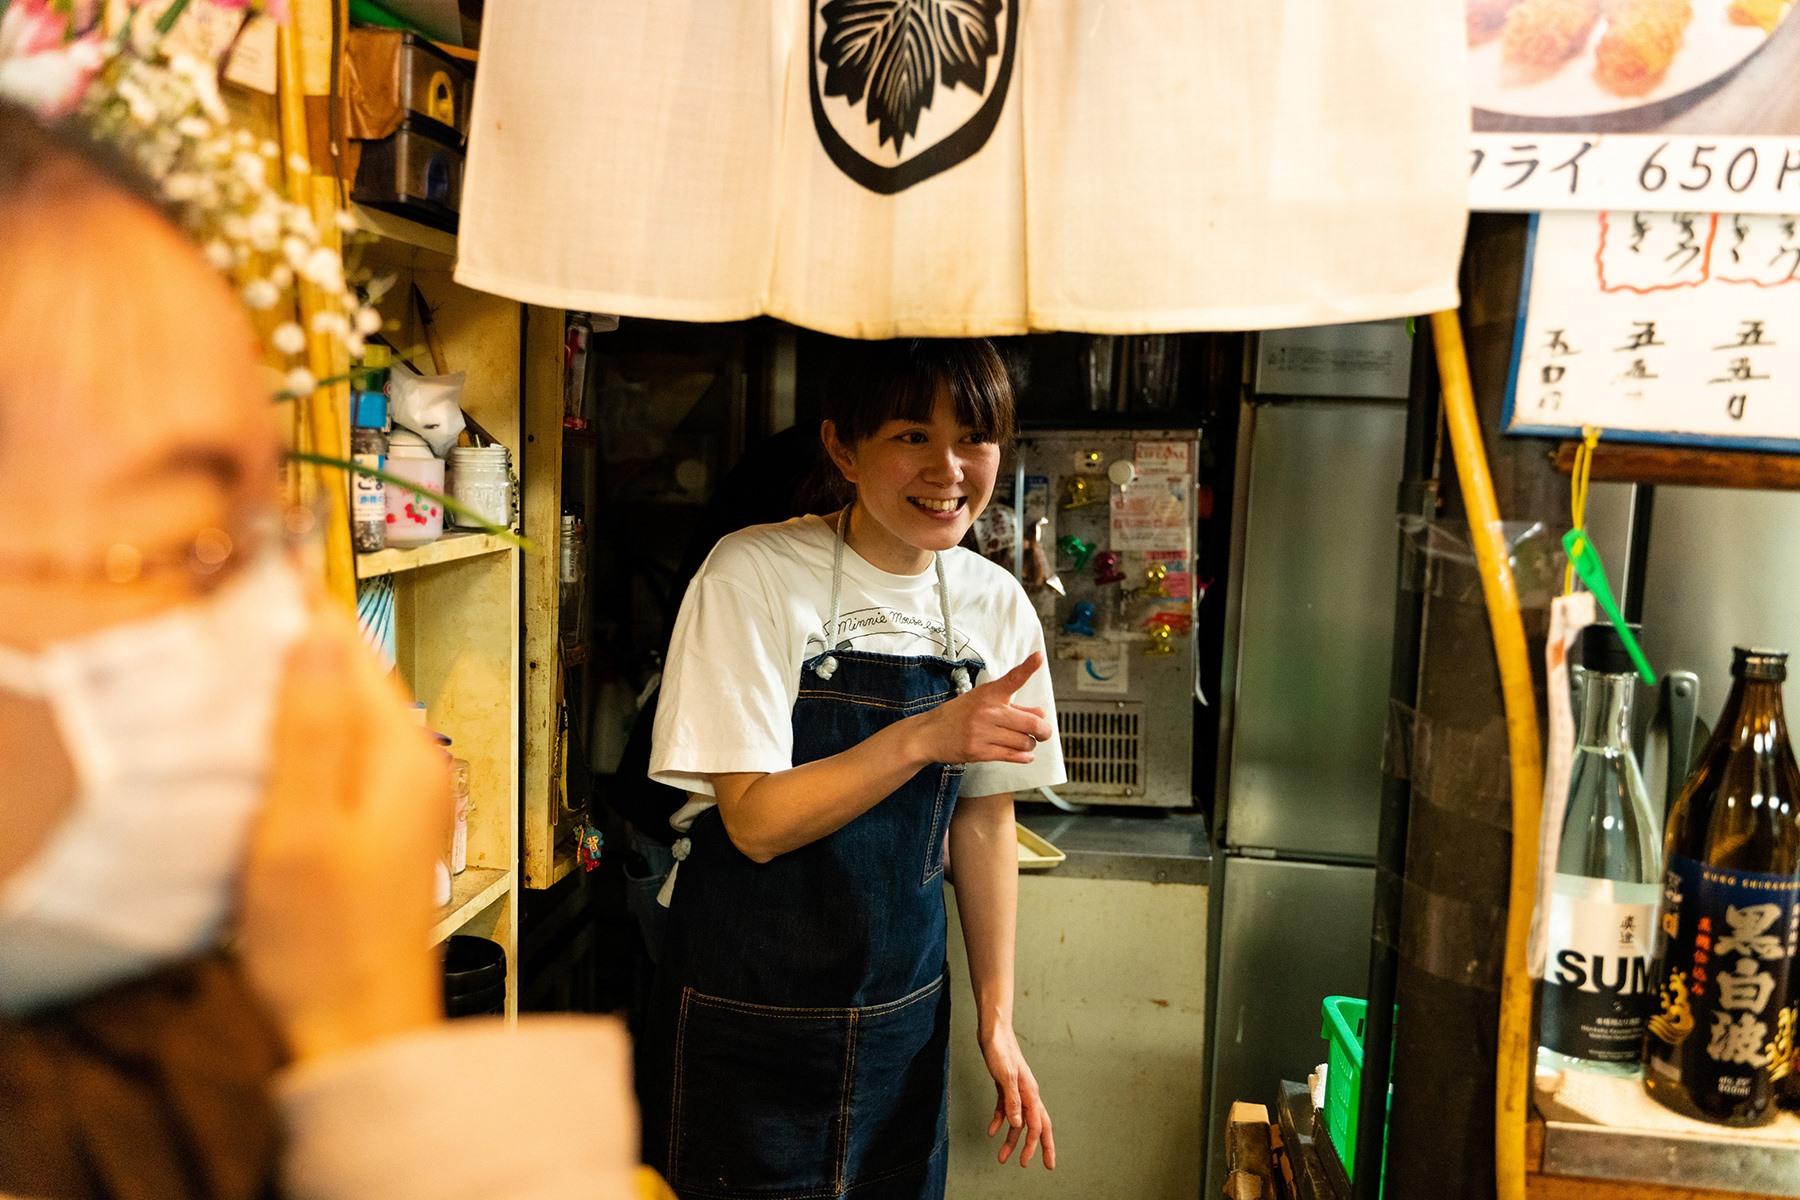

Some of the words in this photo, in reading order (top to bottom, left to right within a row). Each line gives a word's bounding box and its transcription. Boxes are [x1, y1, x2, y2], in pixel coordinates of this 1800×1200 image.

[838, 612, 888, 635] Minnie
[889, 611, 923, 627] Mouse
[1706, 903, 1785, 1068] 黒白波
